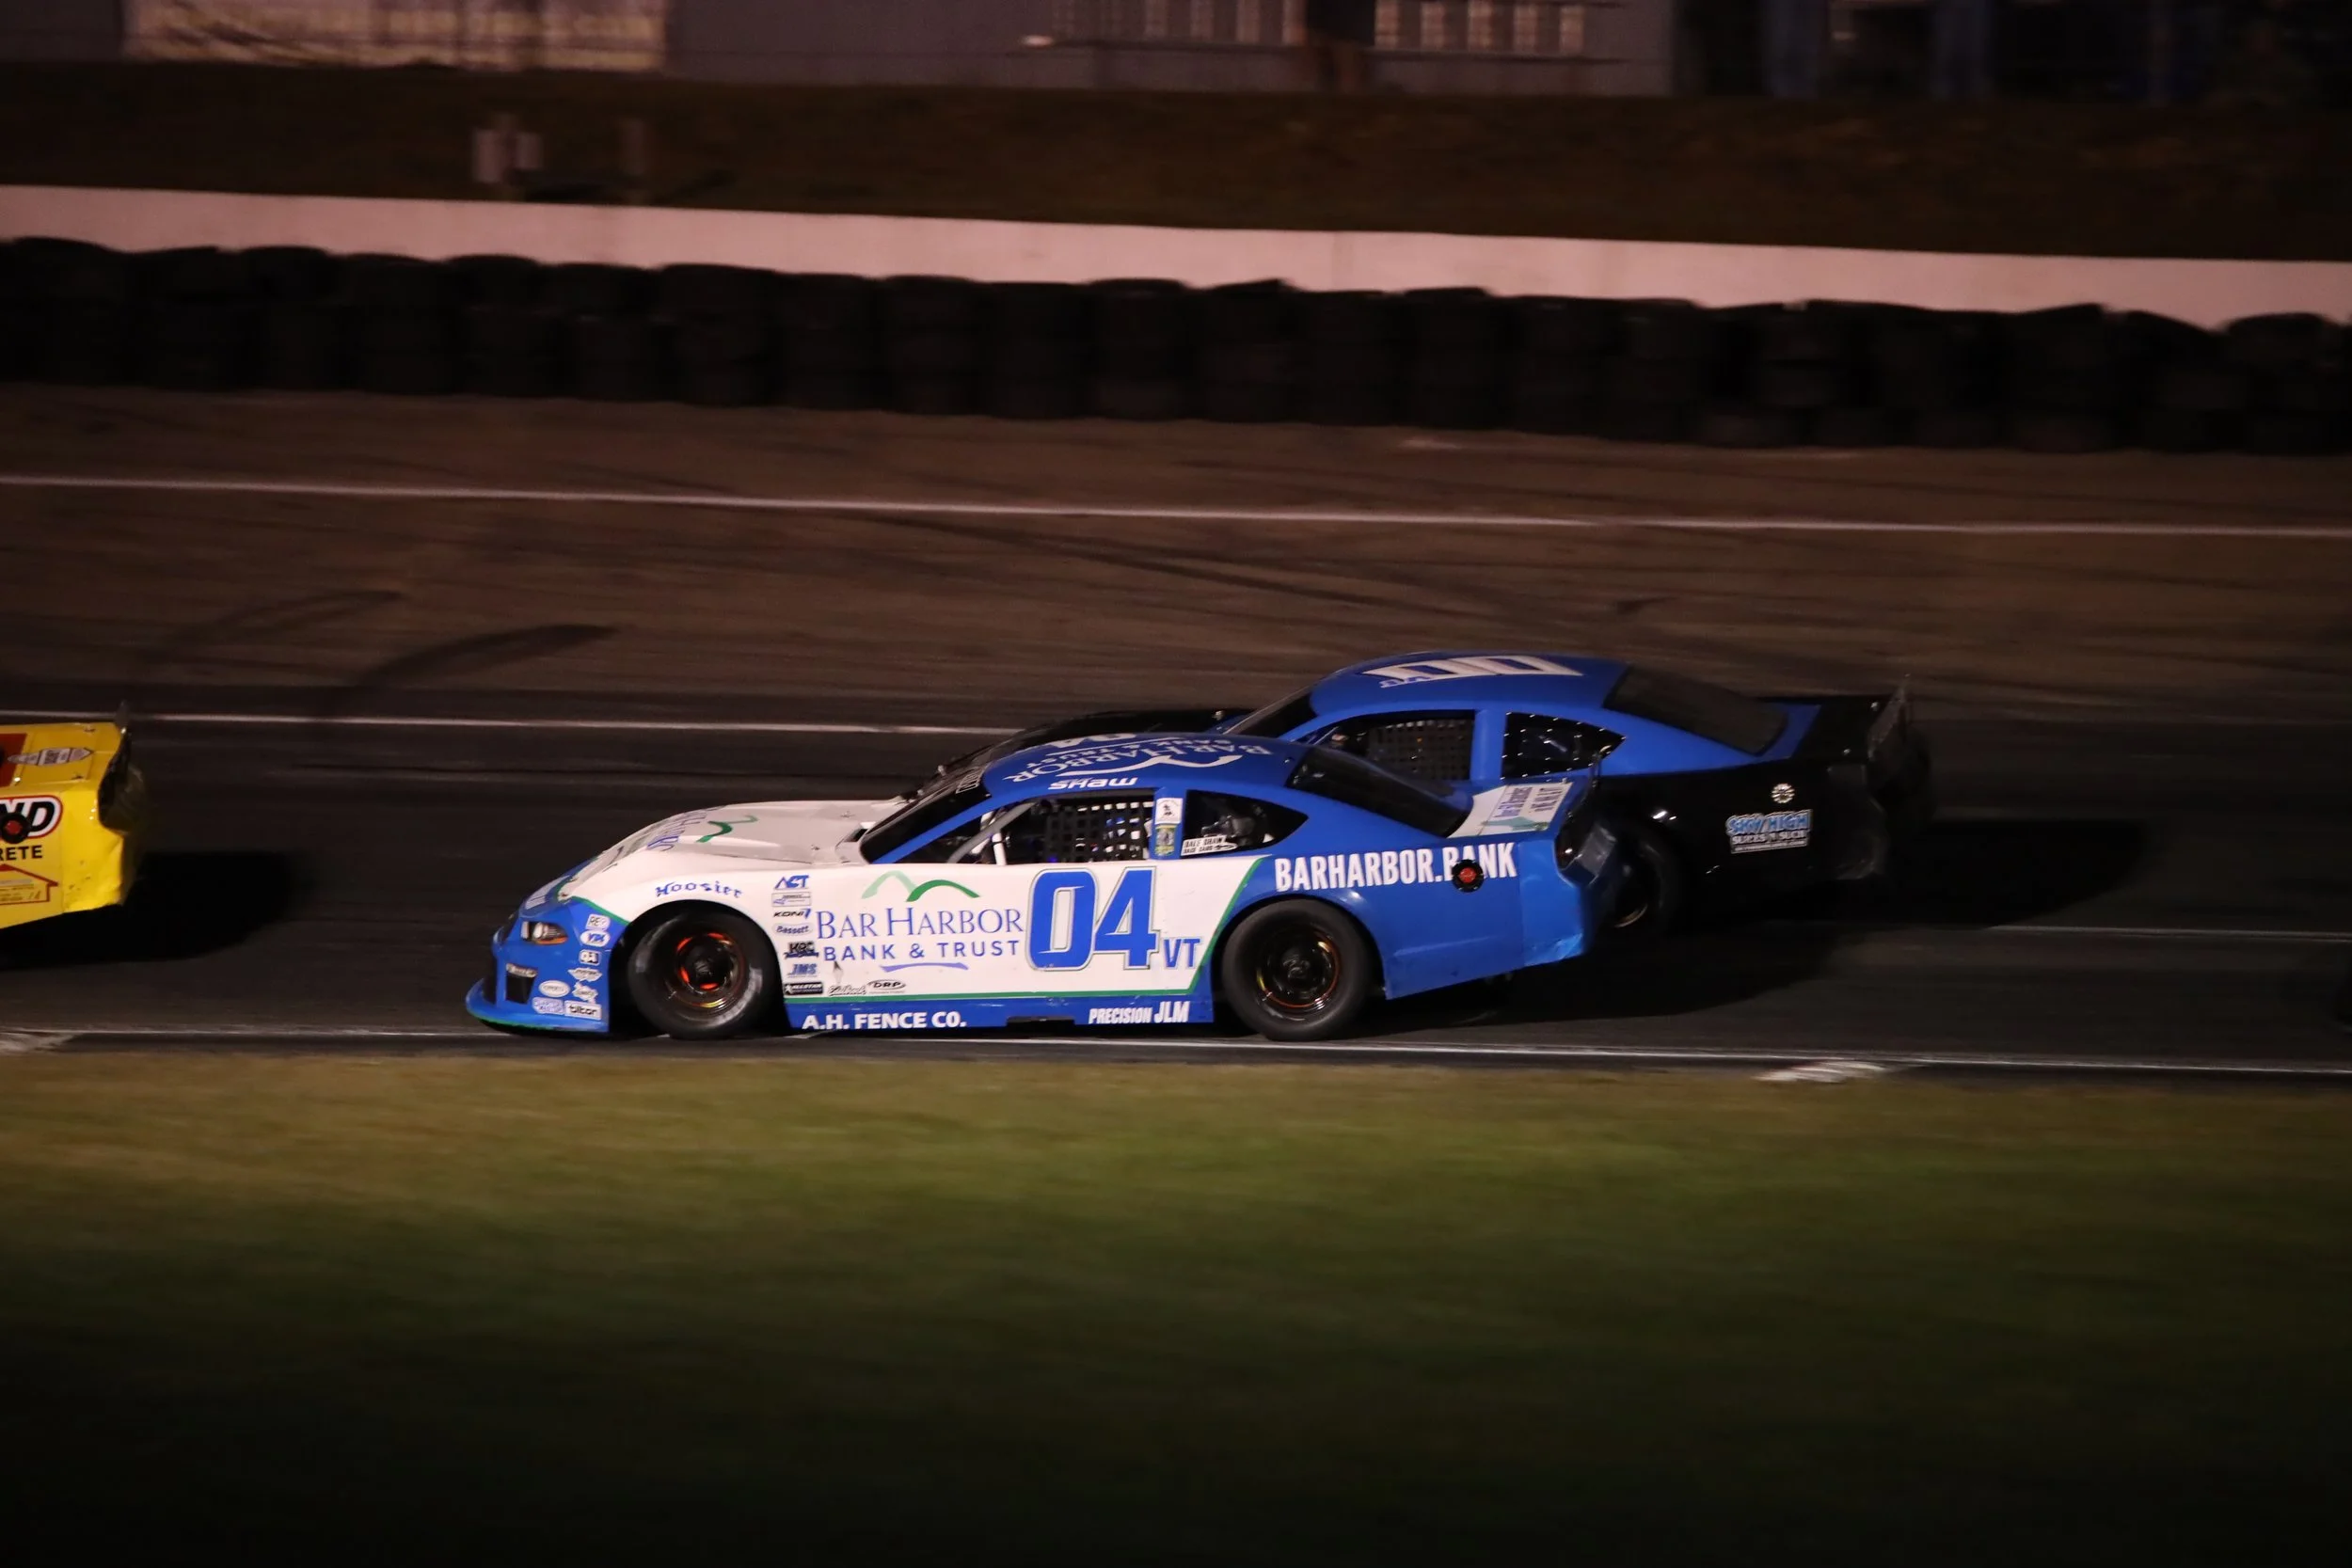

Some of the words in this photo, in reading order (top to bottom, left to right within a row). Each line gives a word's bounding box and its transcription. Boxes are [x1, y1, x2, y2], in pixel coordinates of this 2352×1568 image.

[1002, 746, 1186, 783] HARBOR
[656, 881, 743, 899] Hoosier
[774, 875, 809, 889] ACT
[817, 911, 878, 939] BAR
[886, 907, 1025, 937] HARBOR
[1027, 867, 1158, 970] 04
[824, 943, 896, 961] BANK
[910, 942, 925, 958] &
[937, 941, 1020, 958] TRUST
[1164, 939, 1200, 968] VT
[803, 1012, 849, 1030] A.H.
[854, 1011, 928, 1030] FENCE
[1089, 1006, 1153, 1024] PRECISION
[1153, 1001, 1191, 1023] JLM
